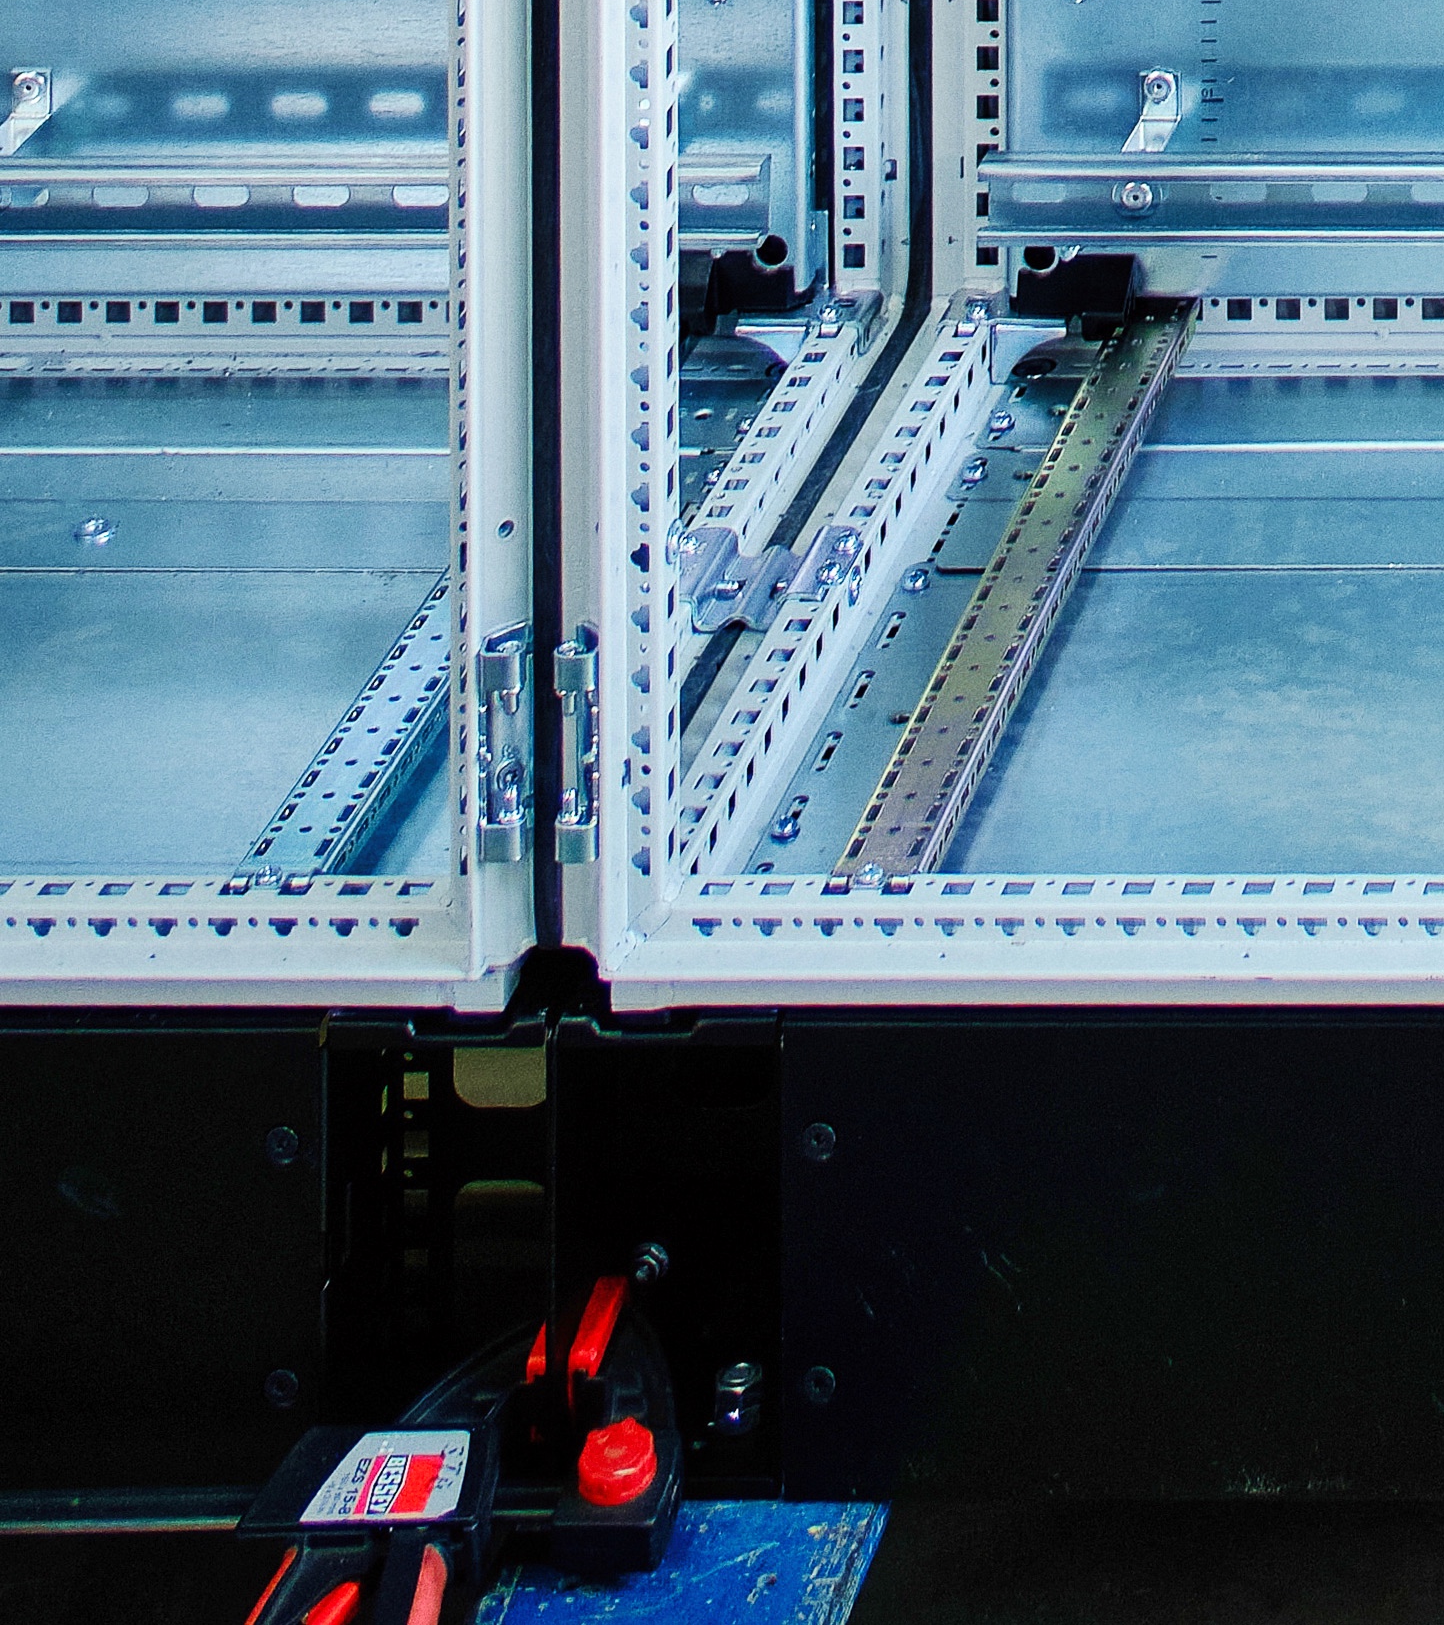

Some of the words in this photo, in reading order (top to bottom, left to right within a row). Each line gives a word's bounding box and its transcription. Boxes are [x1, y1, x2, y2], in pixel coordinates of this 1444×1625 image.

[1201, 88, 1215, 99] 01
[351, 1457, 372, 1485] EZS
[369, 1456, 405, 1513] BESSEY
[338, 1487, 360, 1515] 15-8
